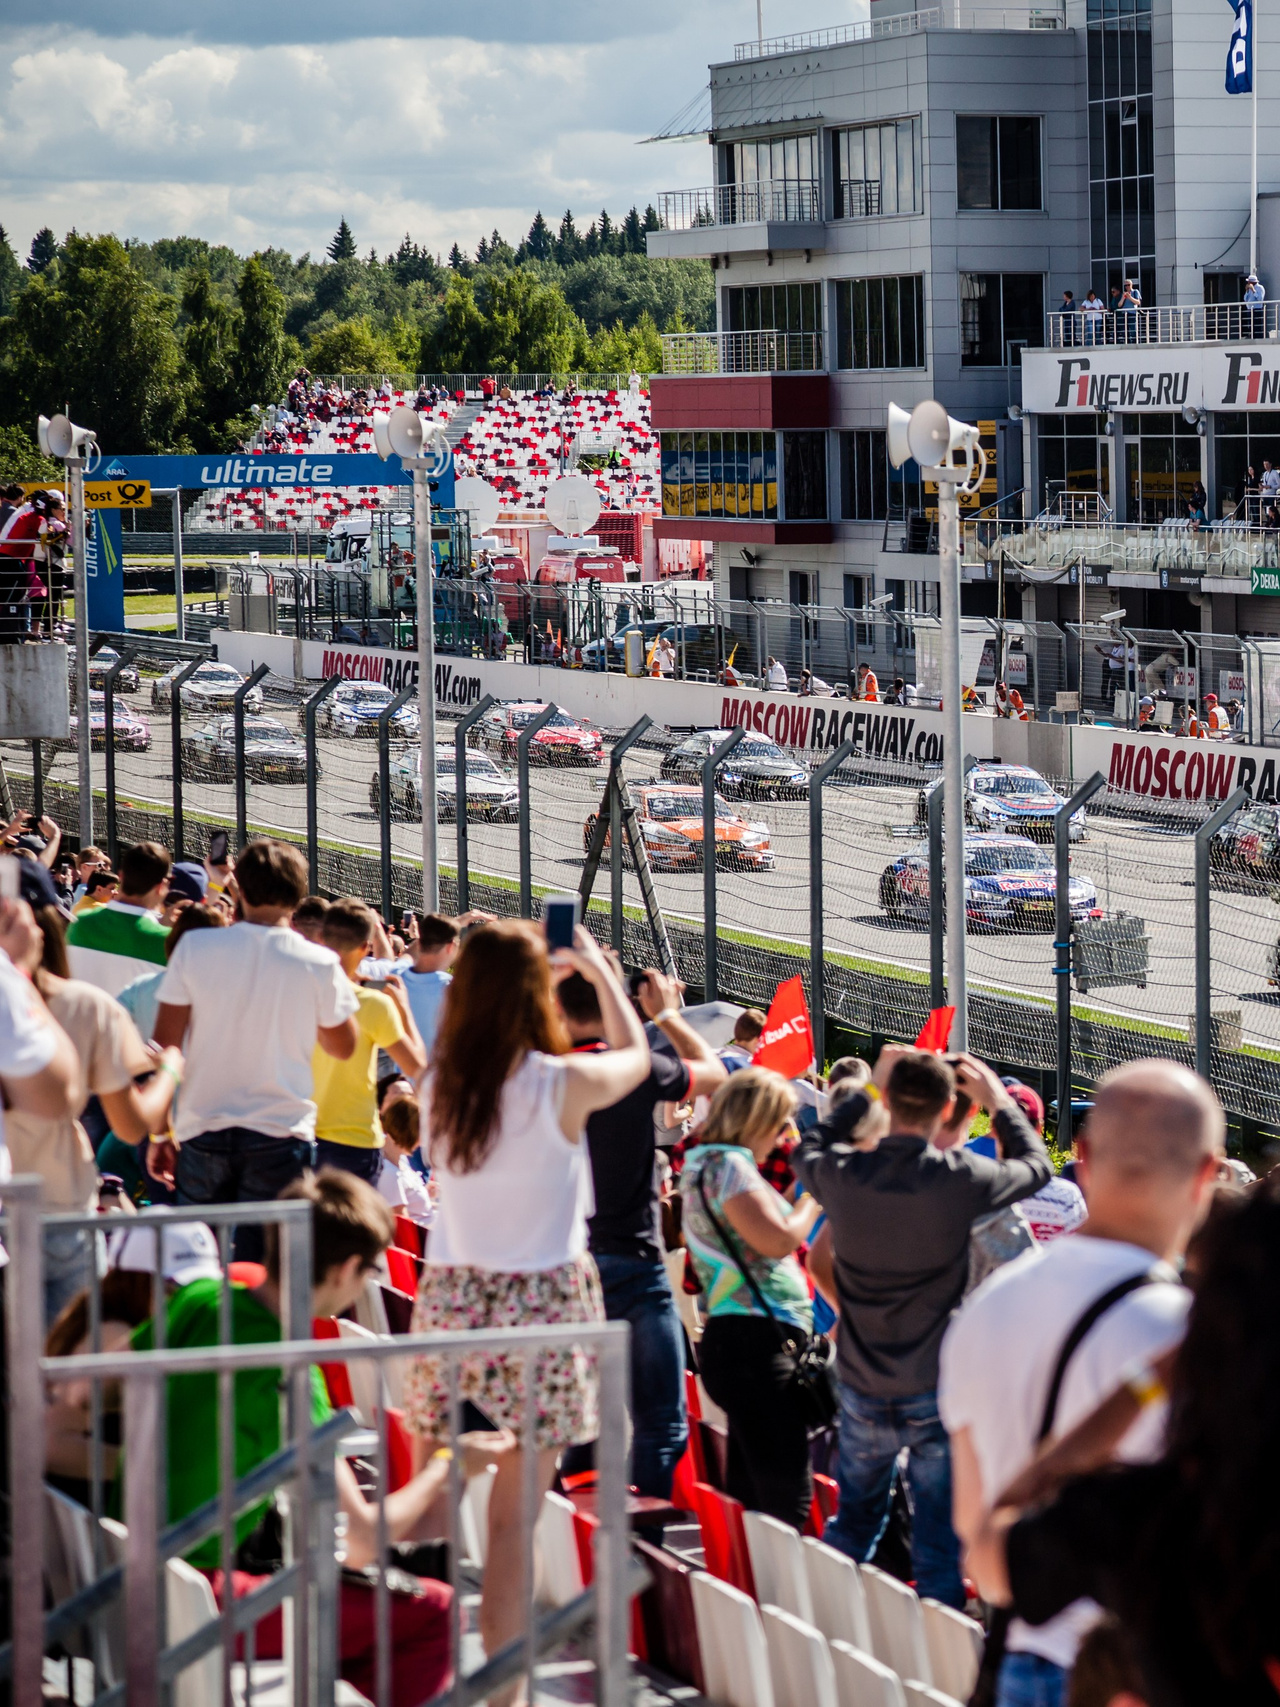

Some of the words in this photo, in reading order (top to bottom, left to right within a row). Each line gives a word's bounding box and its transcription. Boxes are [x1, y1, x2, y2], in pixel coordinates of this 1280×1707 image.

[1056, 358, 1189, 407] F1NEWS.RU
[105, 468, 127, 476] ARAL
[201, 458, 333, 484] ultimate
[84, 489, 112, 502] Post
[1260, 573, 1280, 589] DEKRA
[322, 650, 481, 705] MOSCOWRACEAY.com
[721, 697, 944, 761] MOSCOWRACEWAY.co
[976, 778, 995, 789] 31
[999, 879, 1031, 891] Red
[1032, 879, 1056, 890] Bu
